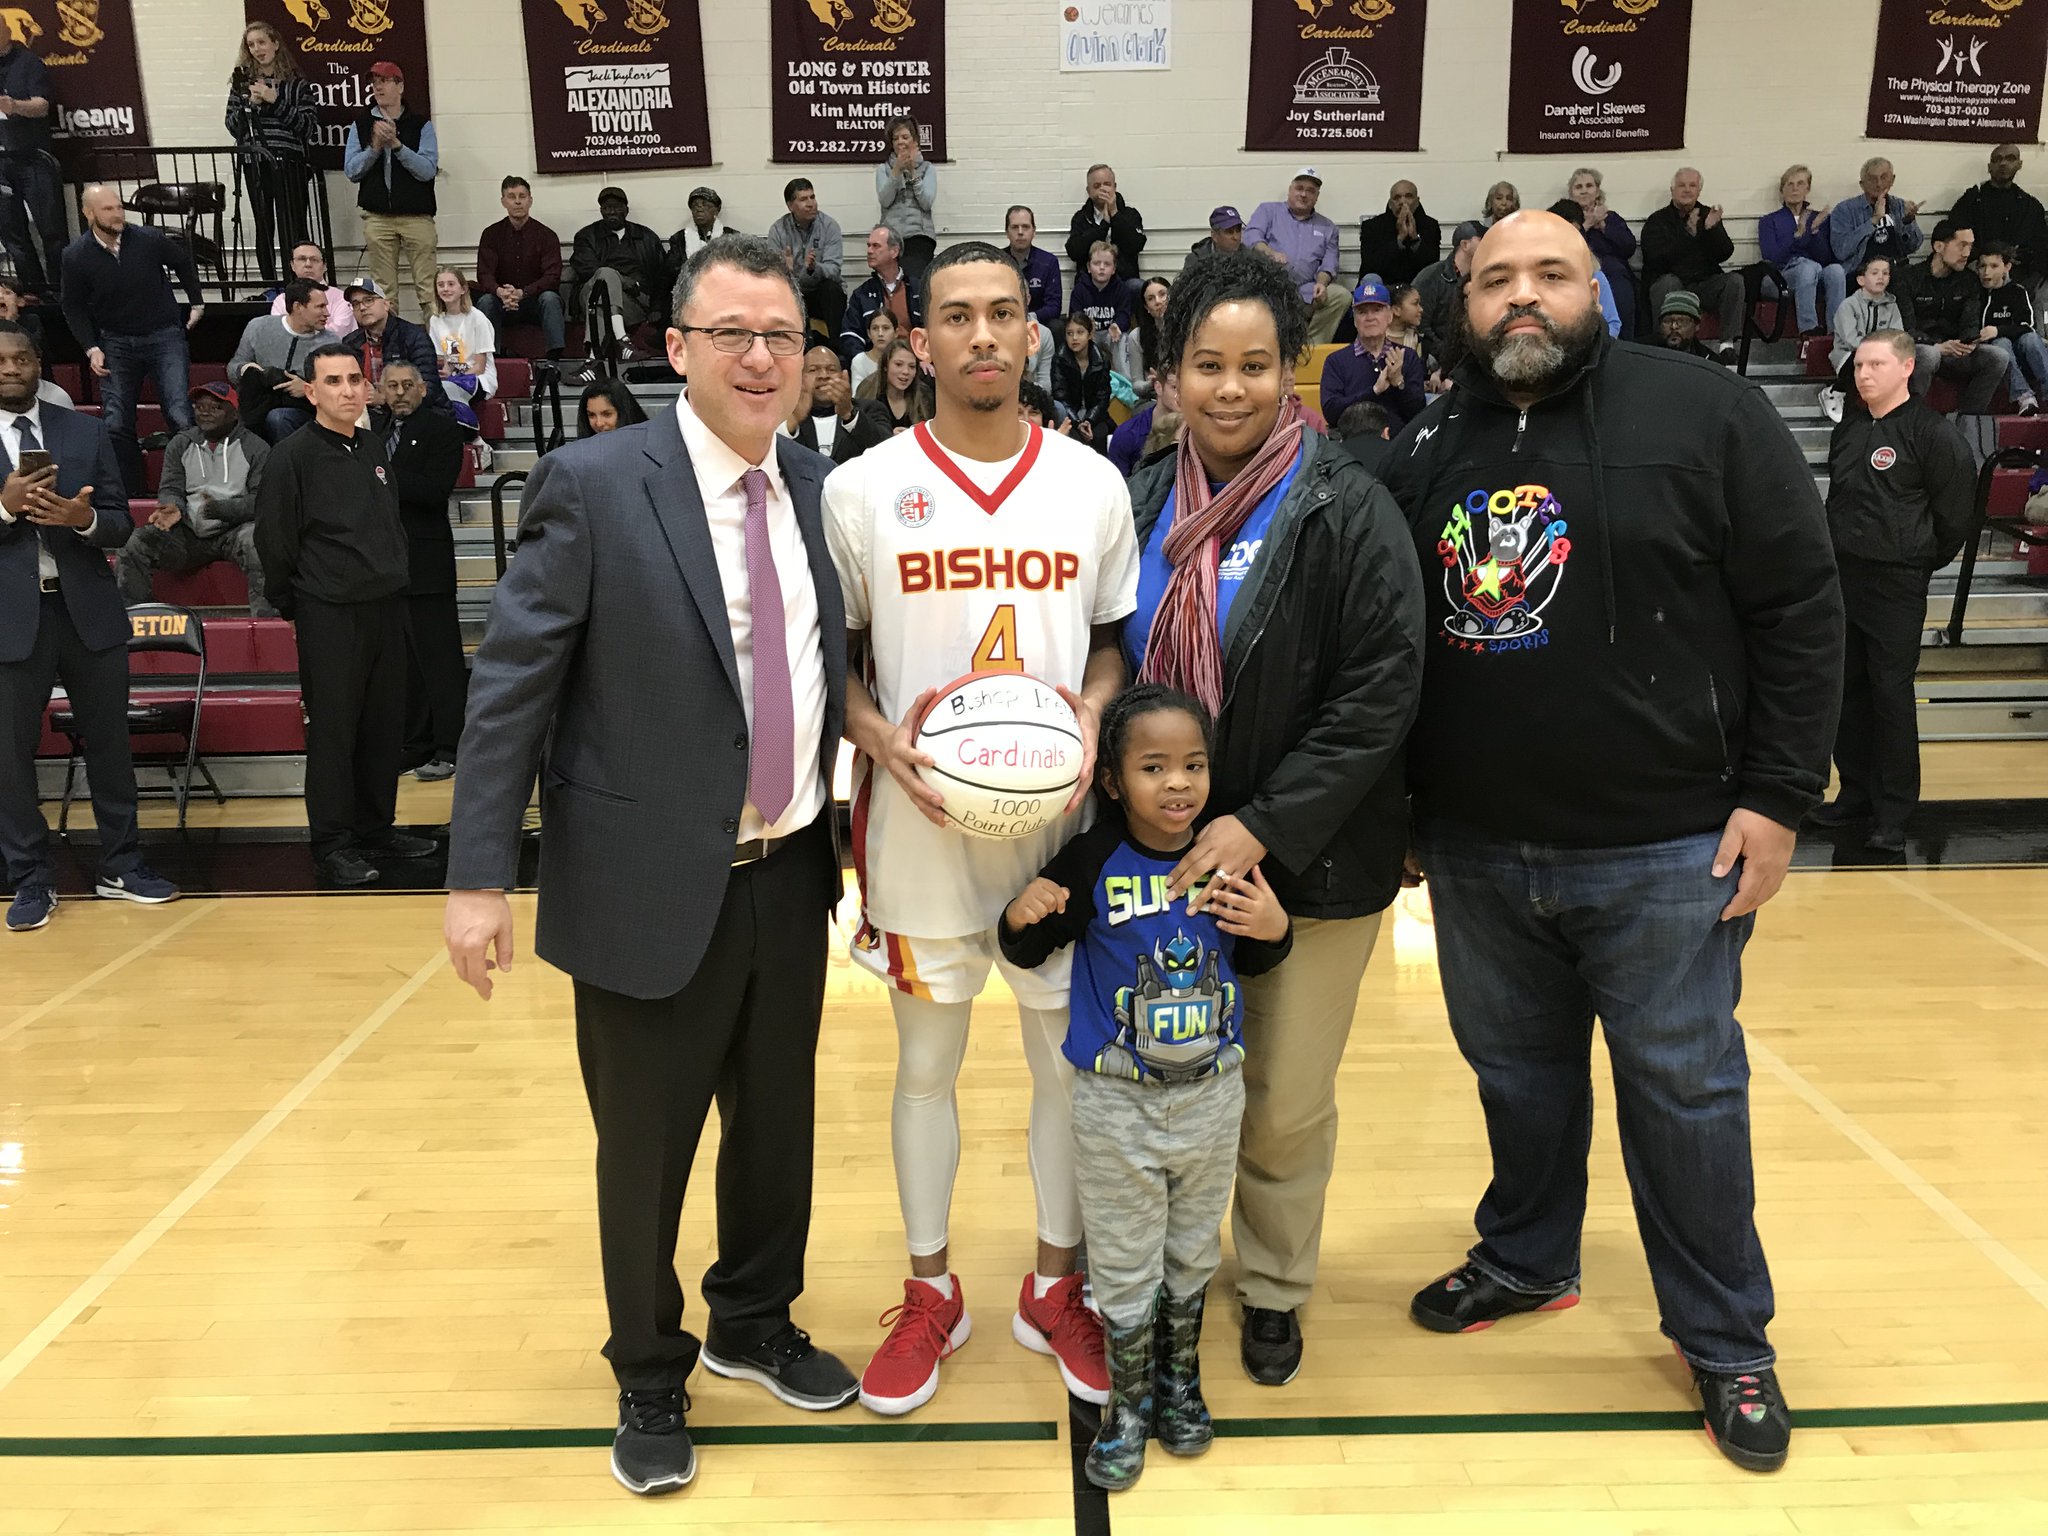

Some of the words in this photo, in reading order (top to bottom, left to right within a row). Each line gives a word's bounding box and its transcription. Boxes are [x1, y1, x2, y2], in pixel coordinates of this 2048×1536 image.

[327, 62, 349, 75] The
[788, 62, 837, 77] LONG
[842, 62, 856, 77] &
[861, 61, 931, 77] FOSTER
[788, 80, 815, 95] Old
[819, 80, 863, 95] Town
[868, 80, 930, 95] Historic
[1888, 77, 1908, 90] The
[1911, 78, 1952, 94] Physical
[1955, 81, 2000, 96] Therapy
[2003, 82, 2031, 95] Zone
[567, 87, 673, 113] ALEXANDRIA
[1313, 90, 1360, 98] ASSOCIATES
[1900, 94, 2016, 105] www.physicaltherapyzone.com
[811, 103, 843, 118] Kim
[848, 103, 911, 118] Muffler
[1544, 103, 1594, 116] Danaher
[1602, 102, 1645, 115] Skewes
[1925, 104, 1989, 116] 703-837-0010
[588, 111, 653, 133] TOYOTA
[1286, 110, 1309, 123] Joy
[1313, 110, 1385, 121] Sutherland
[1569, 117, 1576, 125] &
[1578, 116, 1624, 125] Associates
[1884, 114, 1902, 124] 127A
[1903, 114, 1946, 127] Washington
[1948, 117, 1970, 127] Street
[2016, 119, 2026, 128] VA
[836, 120, 885, 130] REALTOR
[585, 134, 661, 146] 703/684-0700
[1296, 128, 1373, 138] 703.725.5061
[1539, 131, 1580, 140] Insurance
[1585, 130, 1611, 139] Bonds
[1615, 129, 1649, 138] Benefits
[551, 145, 697, 159] www.alexandriatoyota.com
[788, 140, 886, 153] 703.282.7739
[897, 547, 1079, 595] BISHOP
[132, 614, 188, 637] ETON
[971, 604, 1025, 672] 4
[1489, 629, 1549, 653] SPORTS
[957, 738, 1065, 769] Cardinals
[989, 798, 1041, 817] 1000
[962, 810, 1006, 834] Point
[1009, 816, 1048, 834] Club
[1154, 1005, 1207, 1041] FUN
